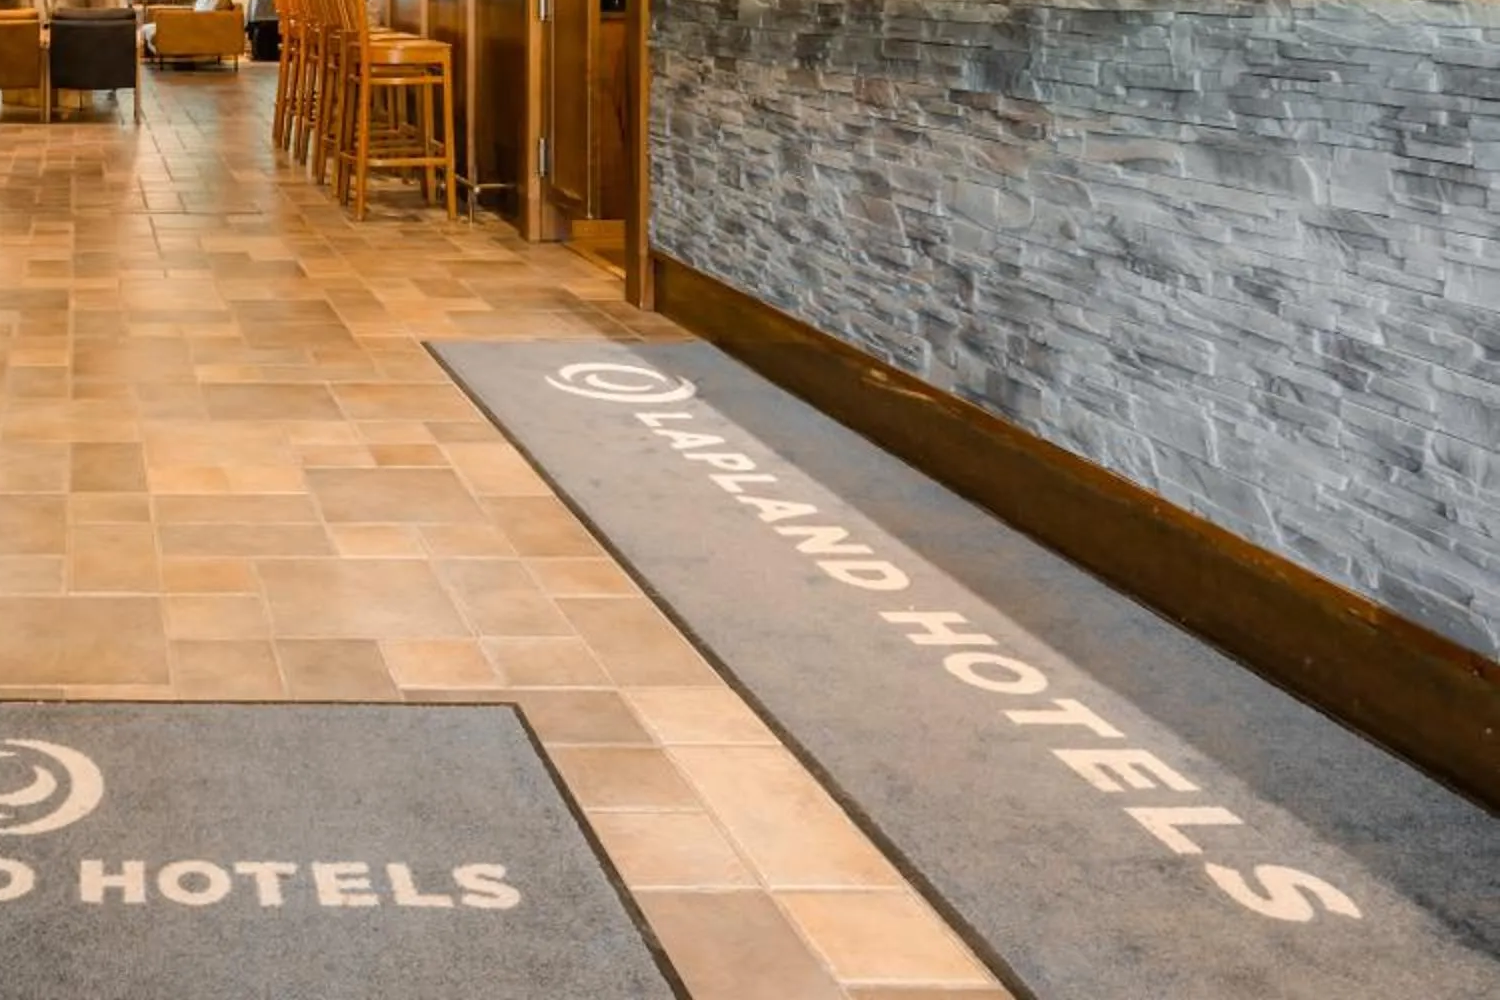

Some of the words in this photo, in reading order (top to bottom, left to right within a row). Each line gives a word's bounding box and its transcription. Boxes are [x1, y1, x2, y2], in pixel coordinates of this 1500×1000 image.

[635, 412, 910, 591] LAPLAND
[880, 609, 1362, 922] HOTELS
[79, 859, 521, 908] HOTELS
